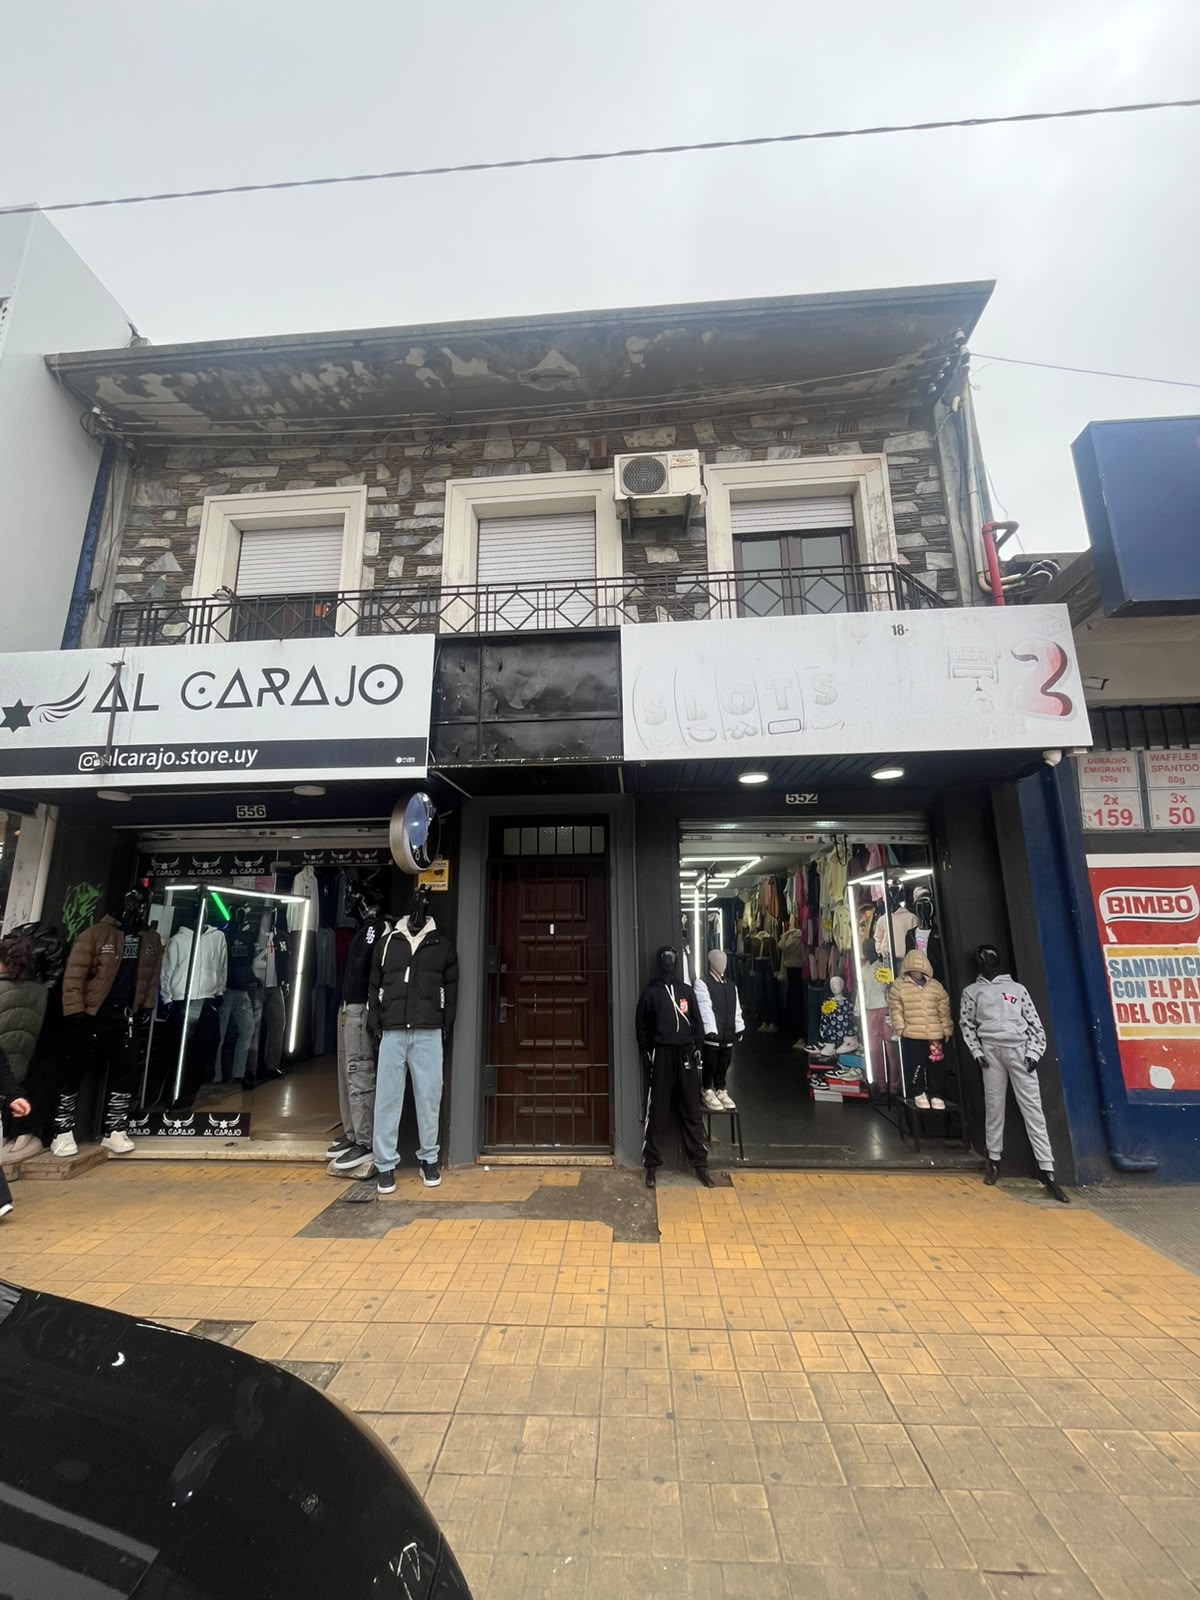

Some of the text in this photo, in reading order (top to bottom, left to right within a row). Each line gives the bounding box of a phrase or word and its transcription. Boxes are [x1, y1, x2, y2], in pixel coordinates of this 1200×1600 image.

[91, 663, 404, 713] AL CARAJO
[1087, 757, 1128, 765] DURAZNO
[1150, 753, 1199, 762] WAFFLES
[1083, 766, 1133, 774] EMIGRANTE
[1168, 776, 1185, 785] 80g
[785, 793, 819, 805] 552
[1103, 795, 1120, 806] 2x
[1170, 793, 1188, 804] 3x
[237, 805, 266, 819] 556
[1168, 806, 1196, 826] 50
[1106, 895, 1194, 915] BIMBO
[1113, 977, 1200, 999] CON EL PA
[1115, 1002, 1151, 1024] DEL
[158, 1128, 196, 1136] AL CARAJO
[203, 1128, 242, 1137] AL CARAJO
